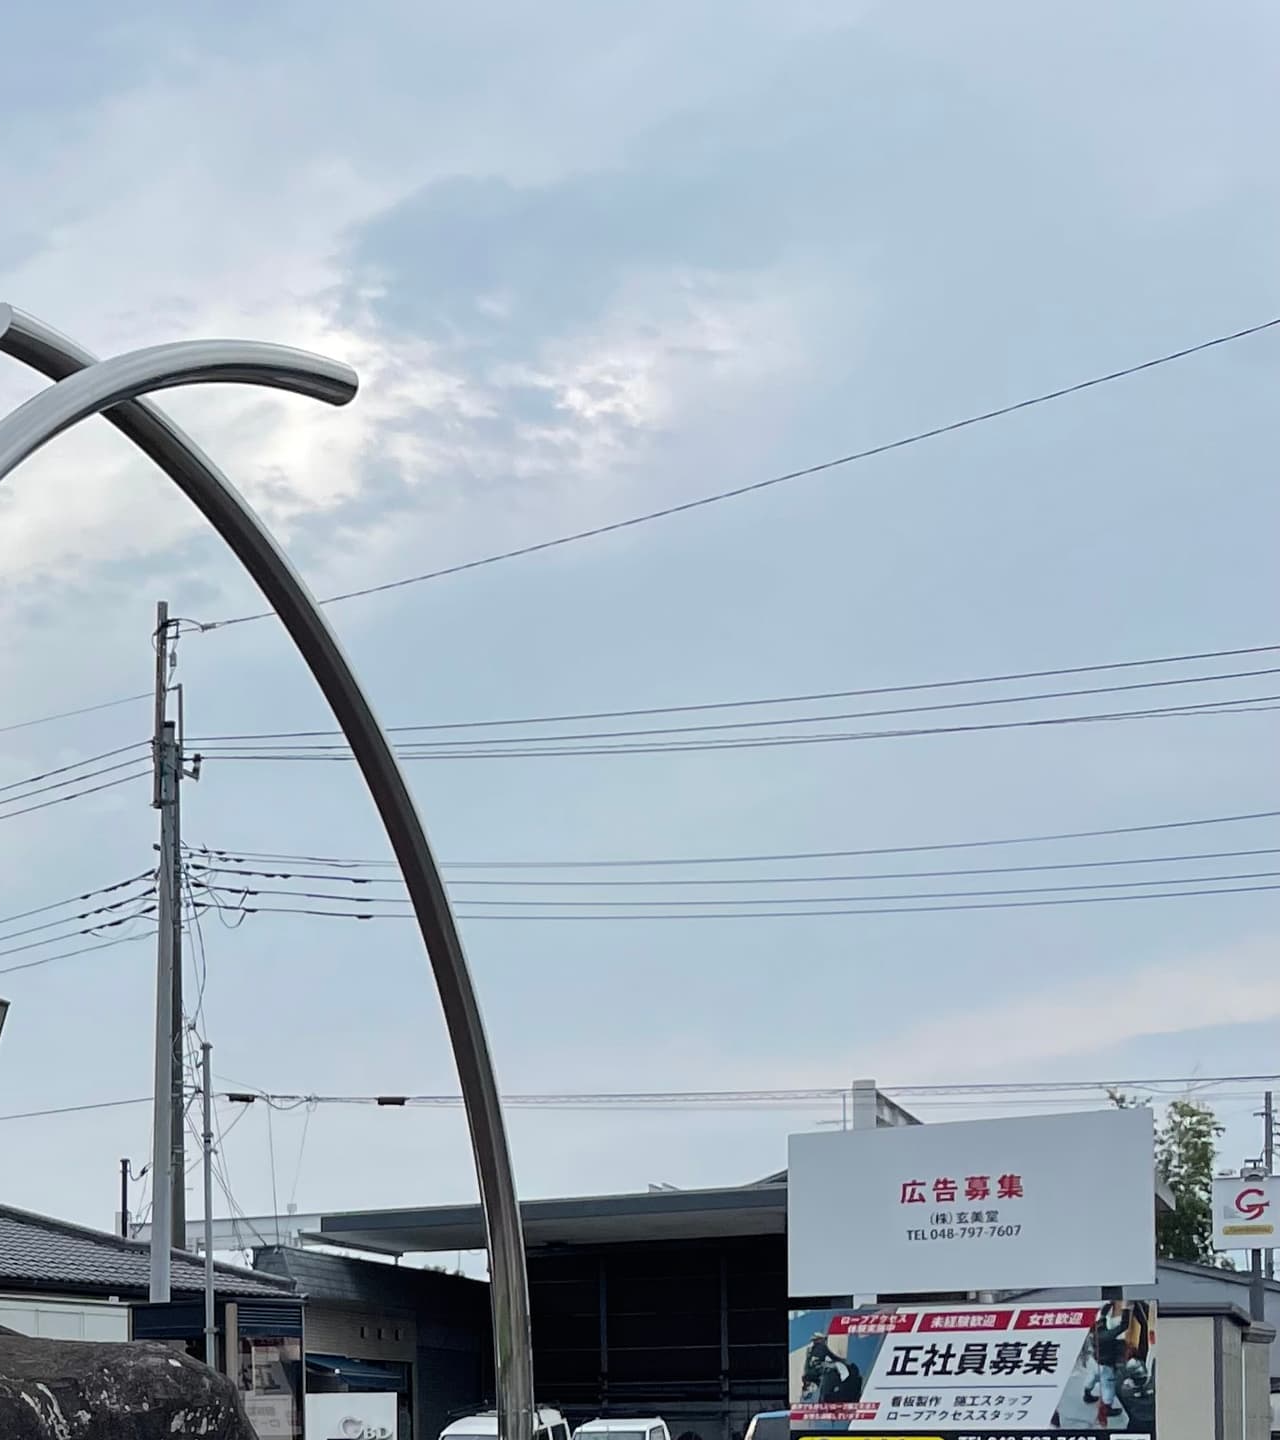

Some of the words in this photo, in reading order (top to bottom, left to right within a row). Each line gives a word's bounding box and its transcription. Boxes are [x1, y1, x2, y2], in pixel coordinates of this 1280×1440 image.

[900, 1173, 1024, 1204] 広告募集
[906, 1229, 928, 1241] TEL
[930, 1224, 1022, 1240] 048-797-7607
[1027, 1311, 1084, 1327] 女性歓迎
[886, 1340, 1061, 1377] 正社員募集
[891, 1395, 940, 1407] 看板製作
